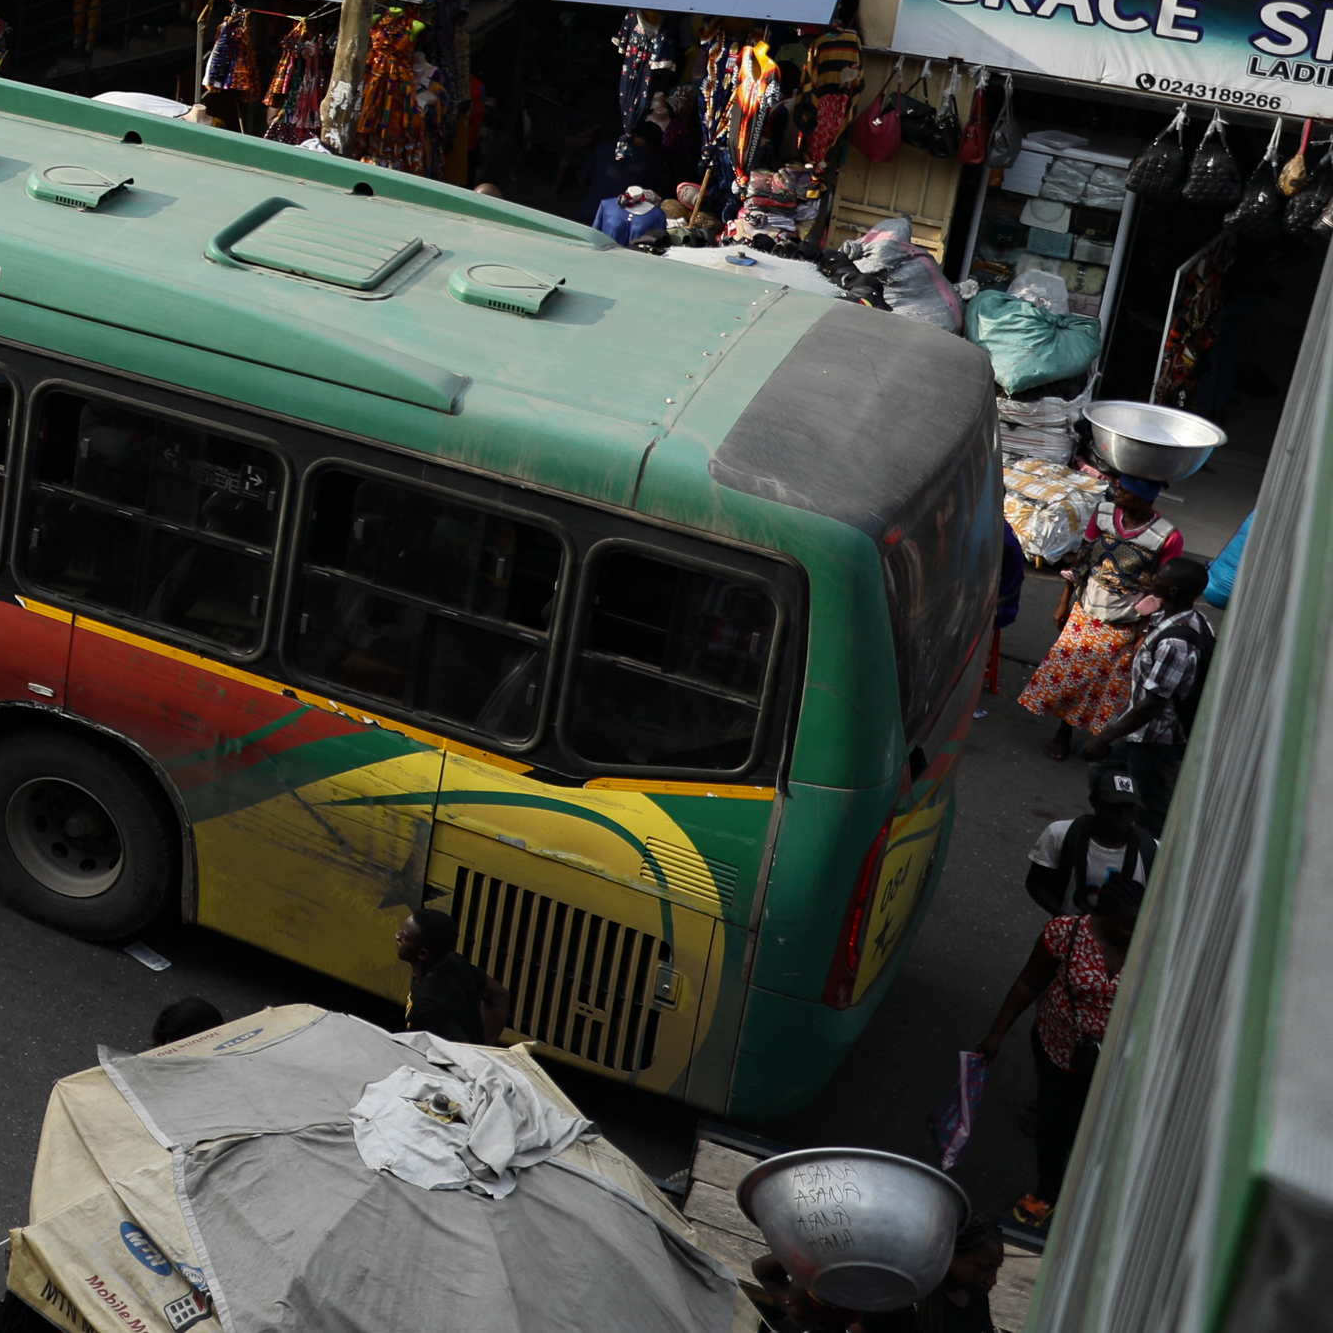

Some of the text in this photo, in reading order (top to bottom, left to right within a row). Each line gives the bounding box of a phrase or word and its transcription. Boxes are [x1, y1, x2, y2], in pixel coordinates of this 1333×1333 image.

[1252, 1, 1333, 61] S
[1159, 79, 1282, 109] 0243189266
[880, 853, 913, 913] 084
[792, 1162, 859, 1191] ASANA
[794, 1182, 861, 1211] ASANA
[124, 1231, 168, 1266] MTN
[85, 1274, 131, 1319] Mobile
